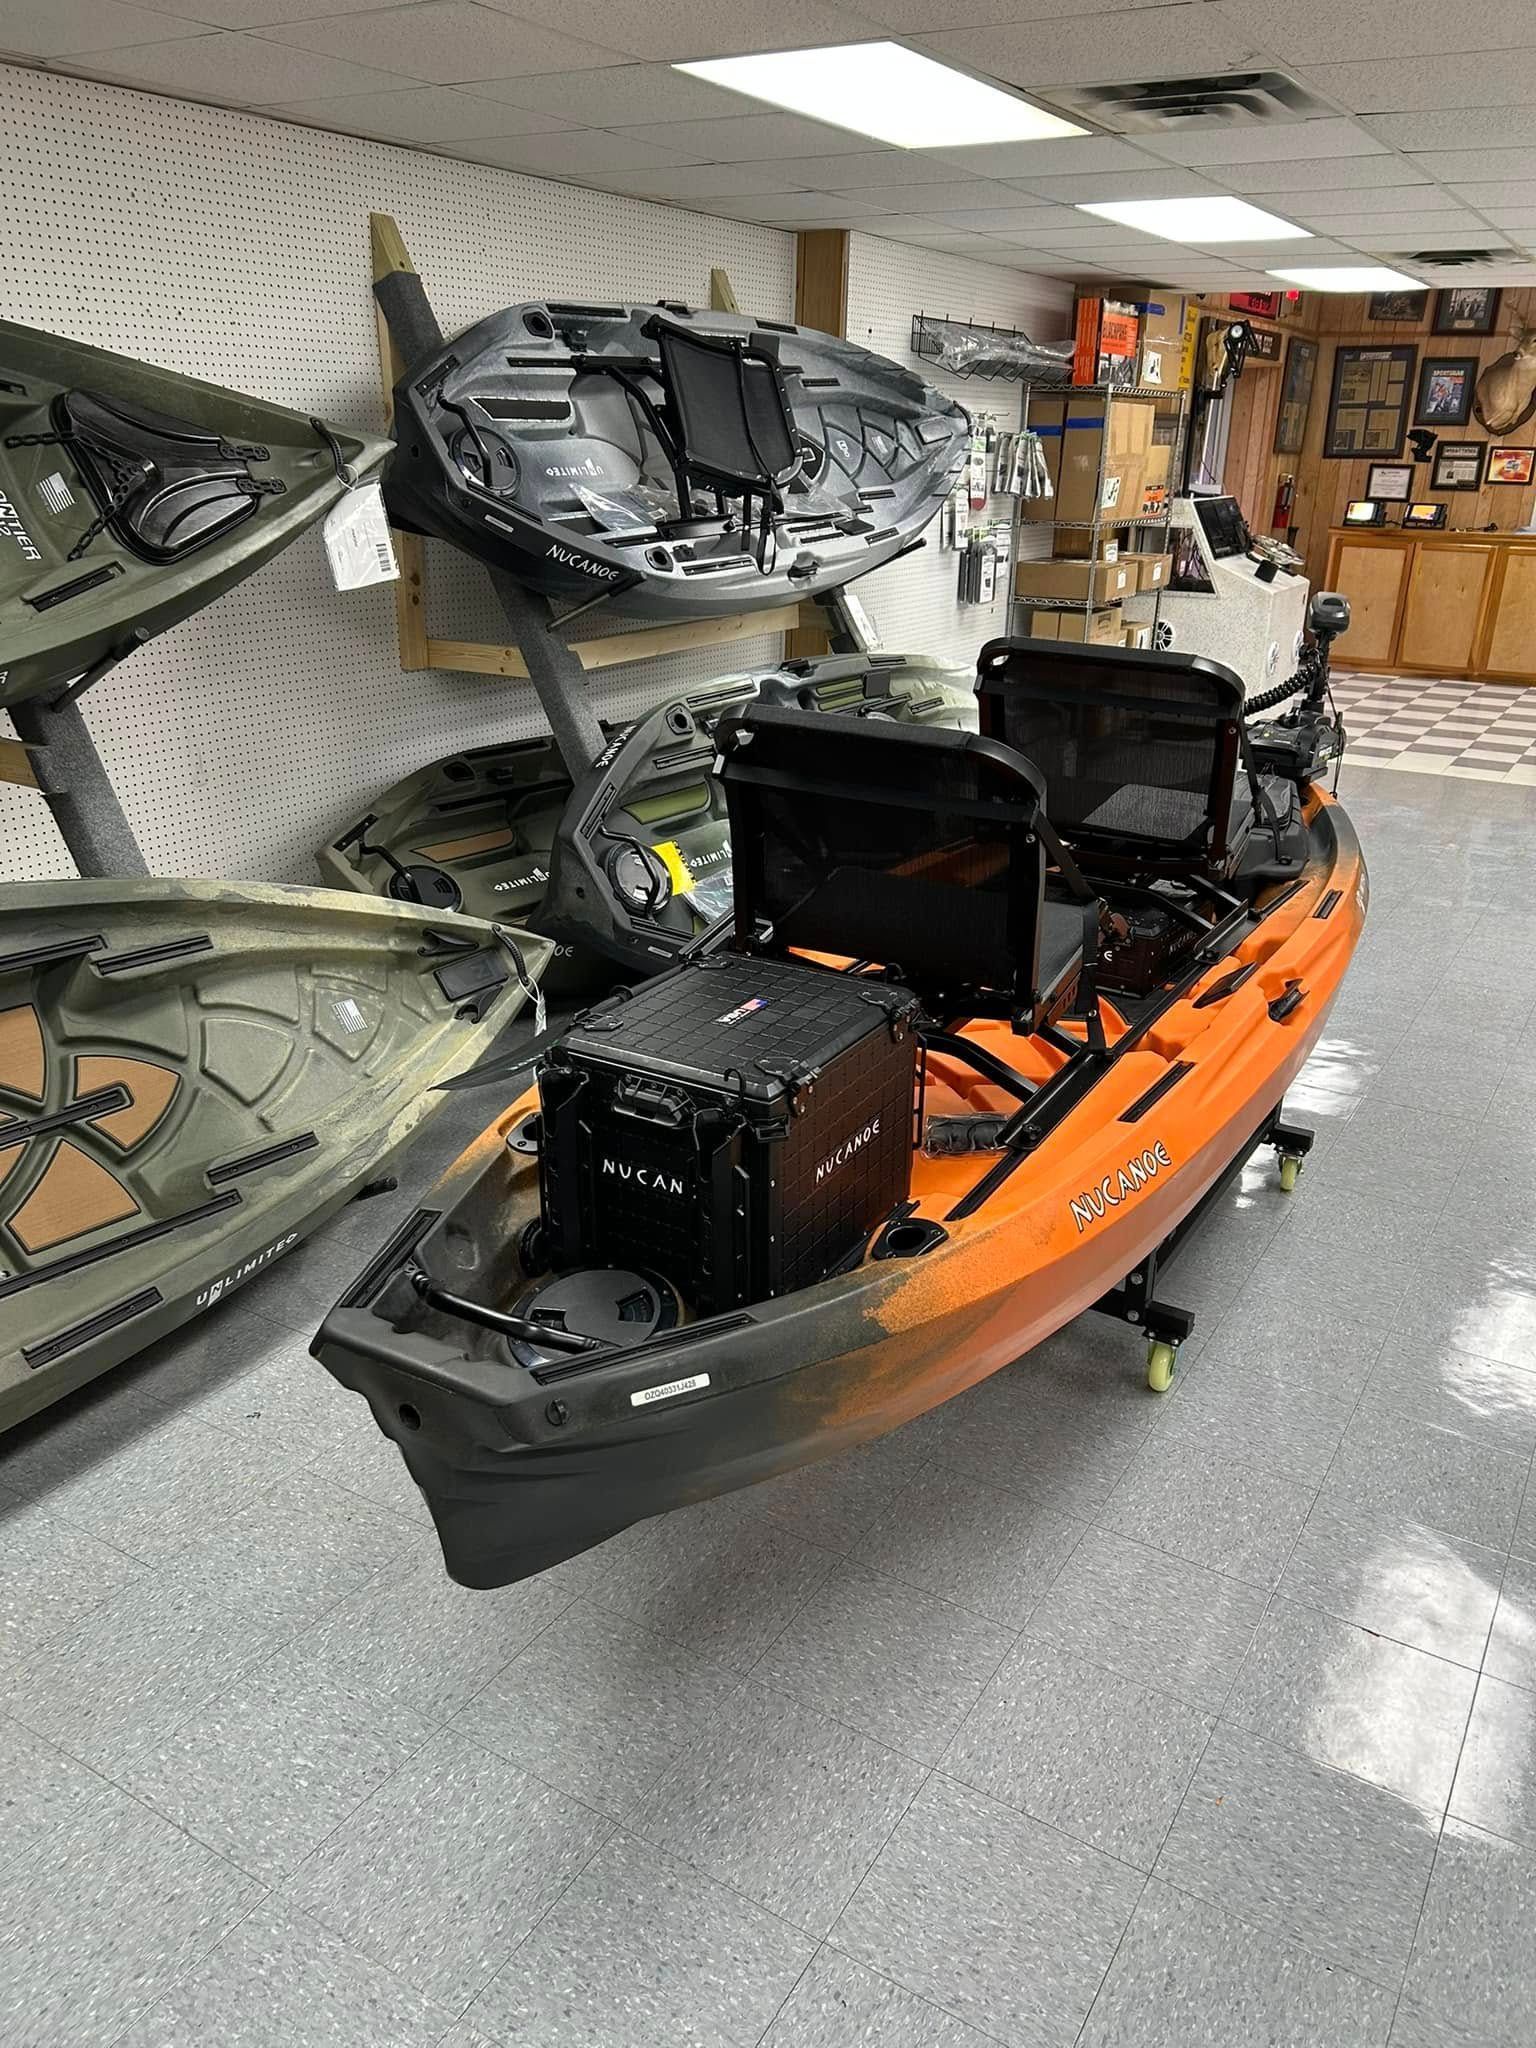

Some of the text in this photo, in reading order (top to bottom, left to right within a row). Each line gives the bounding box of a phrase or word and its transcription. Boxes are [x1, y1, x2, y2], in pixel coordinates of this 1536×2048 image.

[545, 458, 605, 477] UNLIMITED
[546, 544, 620, 581] NUCANOE
[595, 725, 637, 768] NUCANOE
[816, 1119, 880, 1184] NUCANOE
[1069, 1140, 1172, 1233] NUCANOE
[196, 1233, 299, 1308] UNLIMITED
